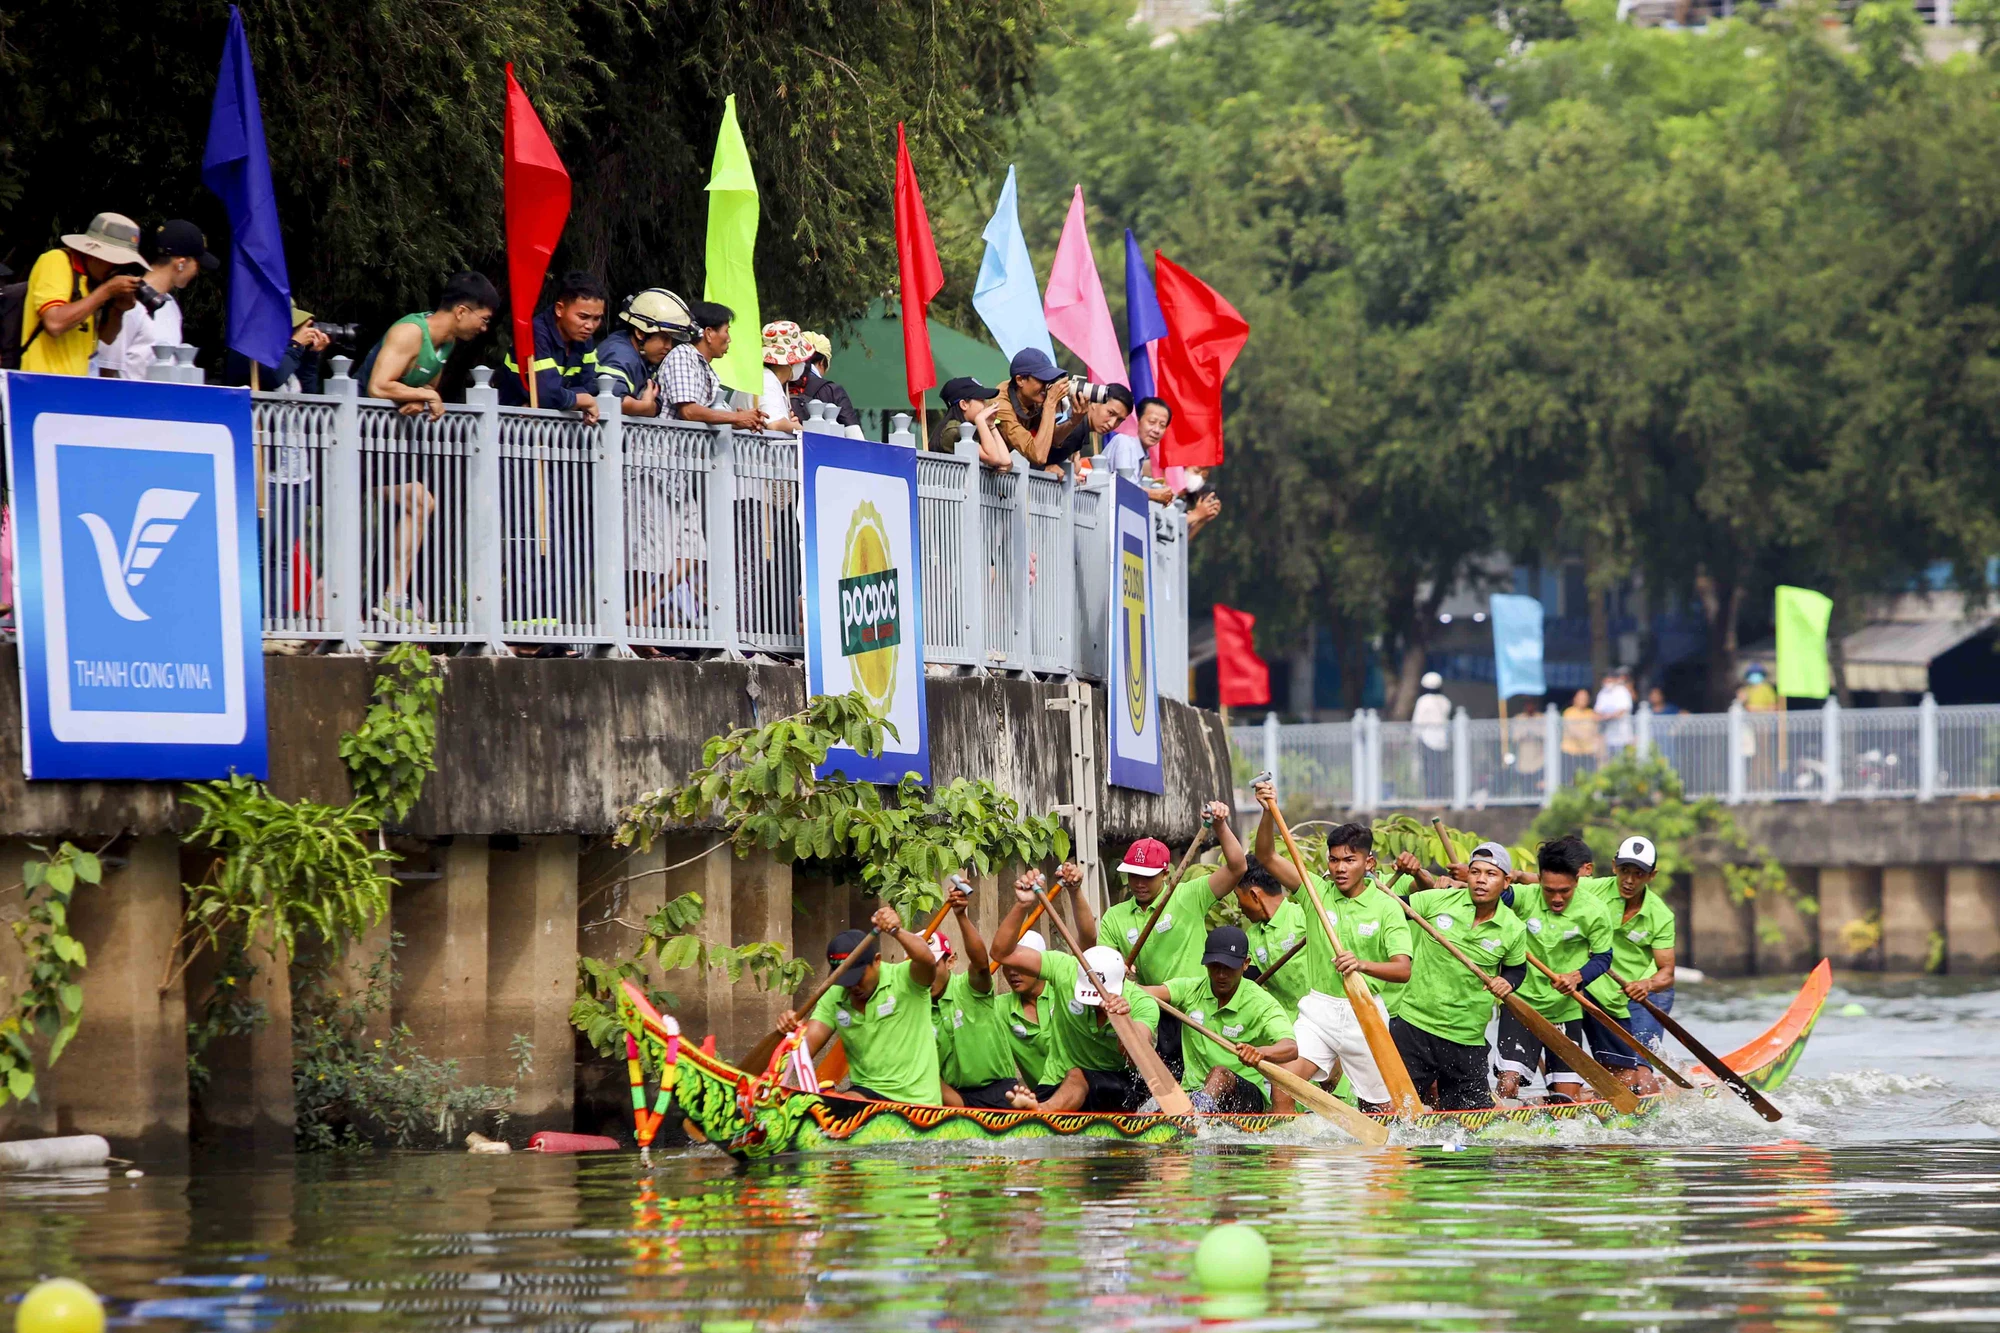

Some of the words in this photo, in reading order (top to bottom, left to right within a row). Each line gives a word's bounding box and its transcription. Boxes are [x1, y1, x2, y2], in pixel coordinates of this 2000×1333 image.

[74, 660, 129, 688] THANH
[130, 661, 175, 689] CONG
[175, 663, 212, 690] VINA
[1081, 990, 1099, 998] TIG
